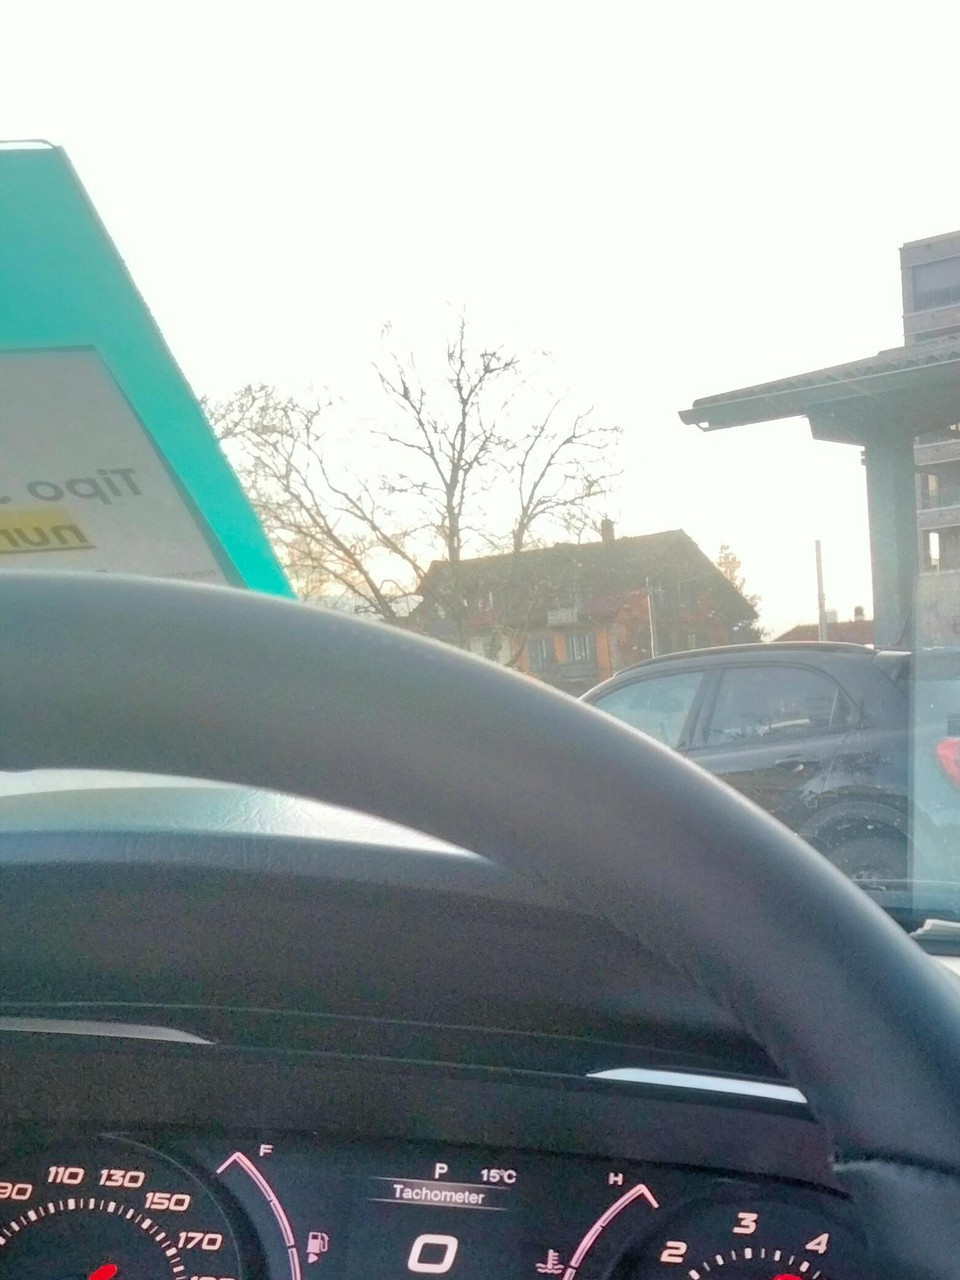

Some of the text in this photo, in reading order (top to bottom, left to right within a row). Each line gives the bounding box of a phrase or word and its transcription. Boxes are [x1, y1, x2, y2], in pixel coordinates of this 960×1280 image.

[47, 1166, 85, 1185] 110
[99, 1169, 145, 1188] 130
[434, 1163, 449, 1179] P
[608, 1172, 623, 1186] H
[144, 1192, 190, 1212] 150
[393, 1184, 485, 1204] Tachometer
[732, 1212, 759, 1235] 3
[177, 1232, 222, 1251] 170
[805, 1233, 830, 1254] 4
[407, 1234, 458, 1274] 0
[660, 1241, 688, 1263] 2
